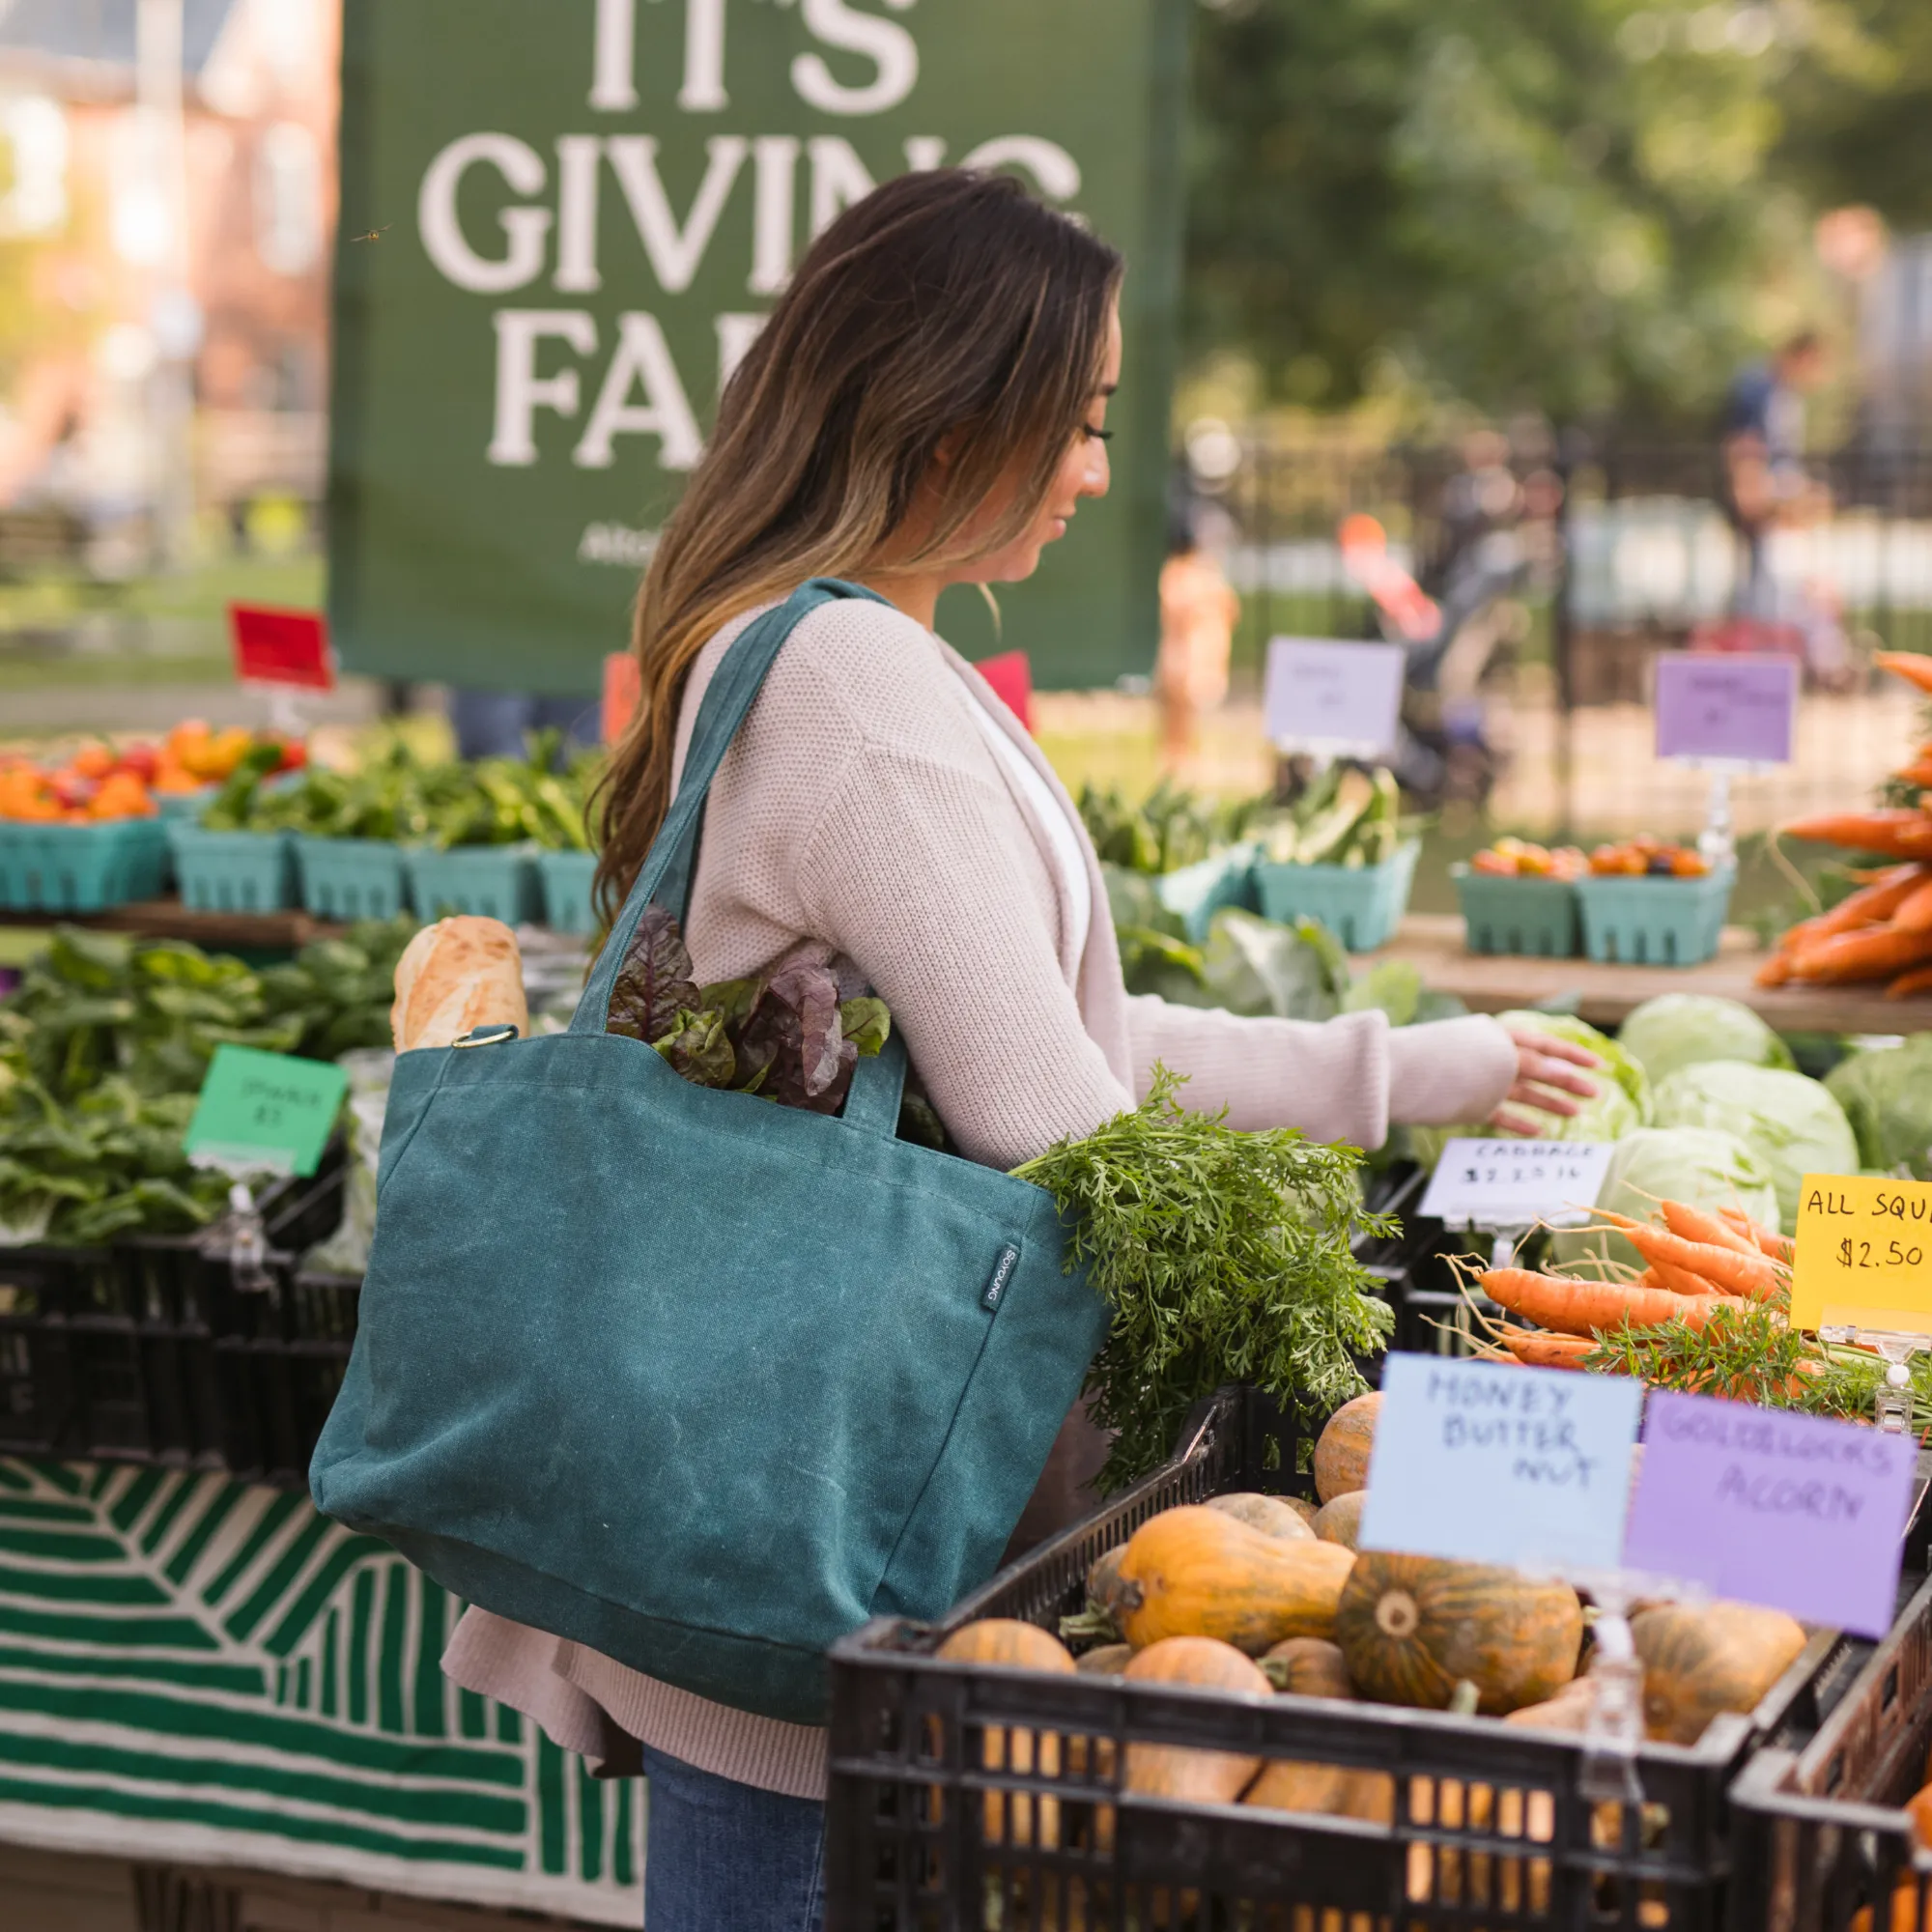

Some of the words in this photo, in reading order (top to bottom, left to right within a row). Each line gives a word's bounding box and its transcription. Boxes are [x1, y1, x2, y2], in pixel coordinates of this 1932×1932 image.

[585, 0, 919, 115] ITS
[486, 309, 773, 469] FA
[1807, 1189, 1855, 1215] ALL
[1871, 1193, 1932, 1224] SQU
[987, 1249, 1016, 1301] SOYOUNG
[1836, 1236, 1923, 1269] $2.50
[1426, 1370, 1575, 1416] HONEY
[1441, 1412, 1582, 1456] BUTTER
[1512, 1456, 1603, 1492] NUT
[1715, 1462, 1866, 1523] ACORN
